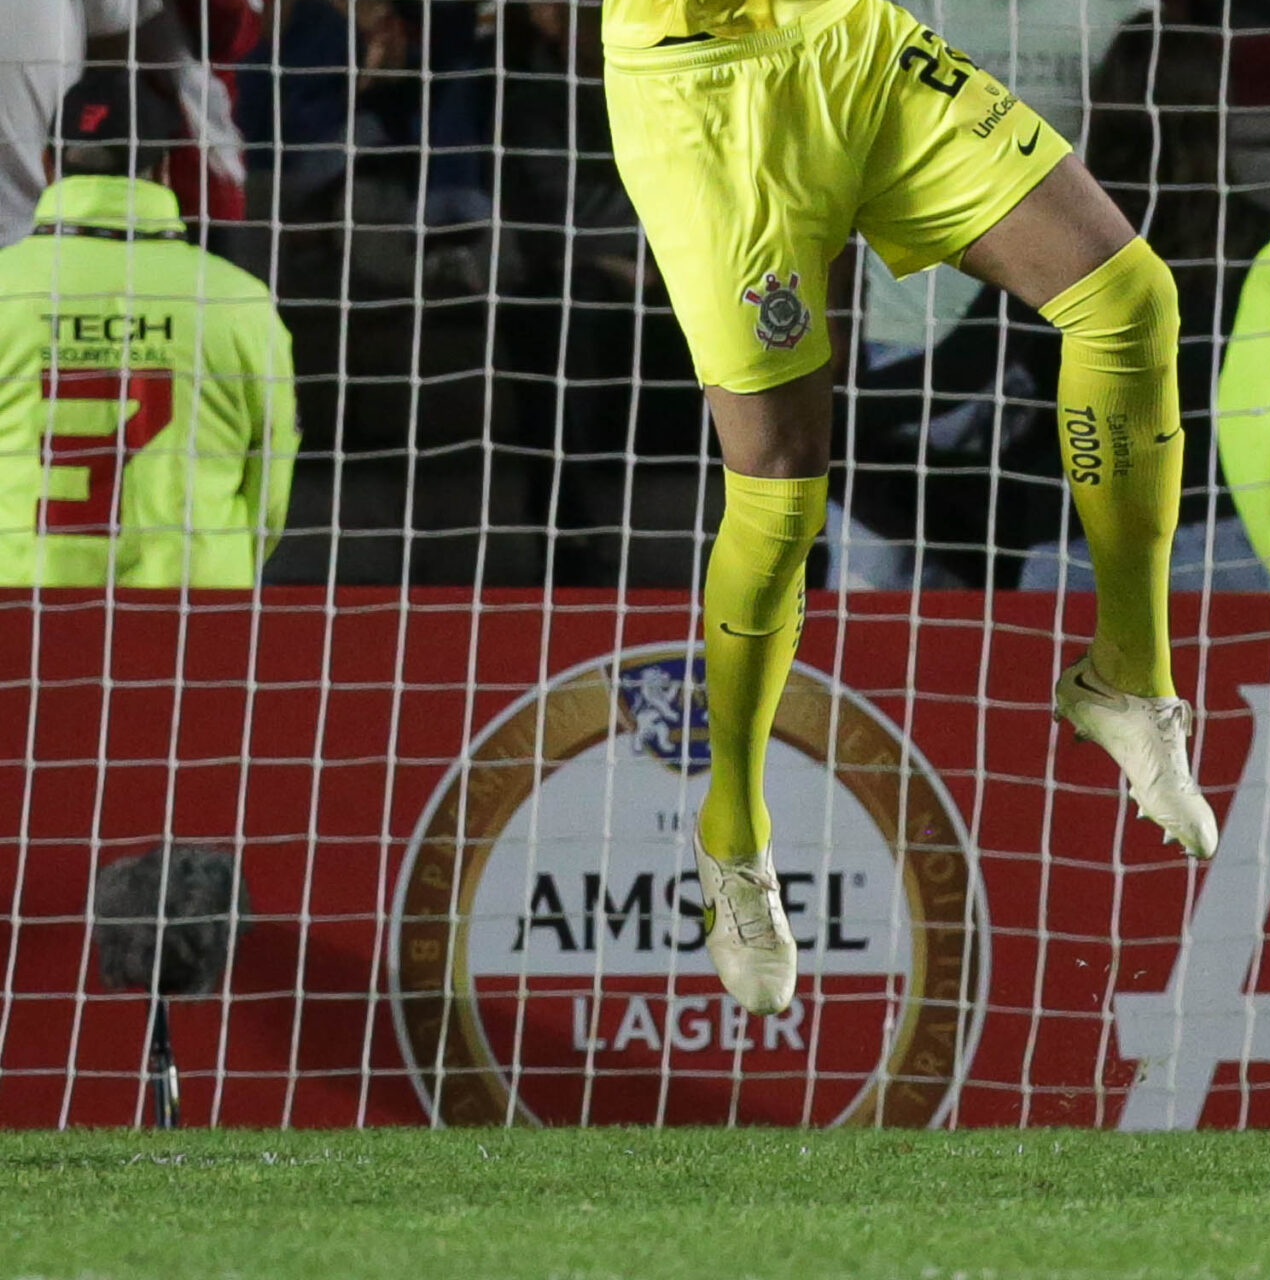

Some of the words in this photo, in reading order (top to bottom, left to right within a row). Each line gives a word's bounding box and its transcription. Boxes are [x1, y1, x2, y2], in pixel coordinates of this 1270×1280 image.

[41, 313, 172, 342] TECH
[1064, 405, 1102, 486] TODOS
[512, 872, 870, 952] AMSEL
[571, 992, 806, 1052] LAGER
